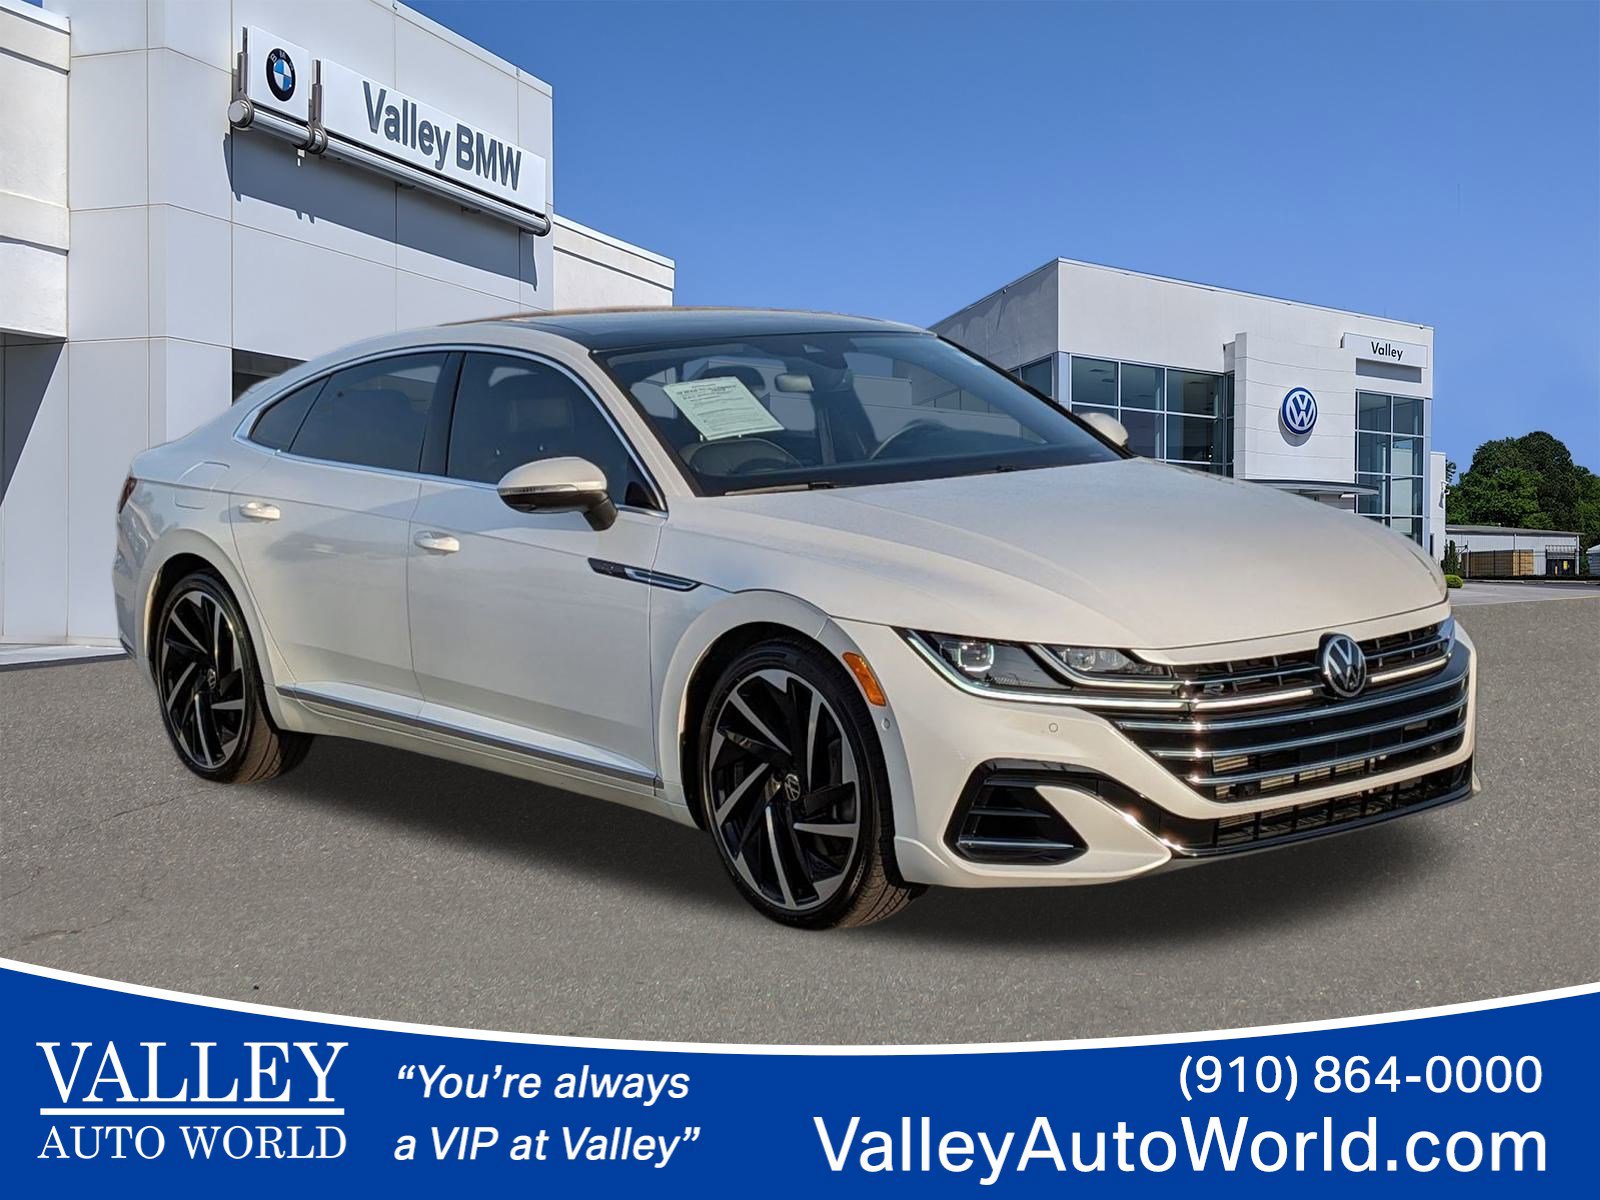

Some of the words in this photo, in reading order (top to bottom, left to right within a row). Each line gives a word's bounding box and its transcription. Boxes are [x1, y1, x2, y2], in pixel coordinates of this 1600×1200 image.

[361, 80, 451, 171] Valley
[455, 122, 522, 191] BMW
[1371, 341, 1404, 361] Valley
[1286, 390, 1316, 431] VW
